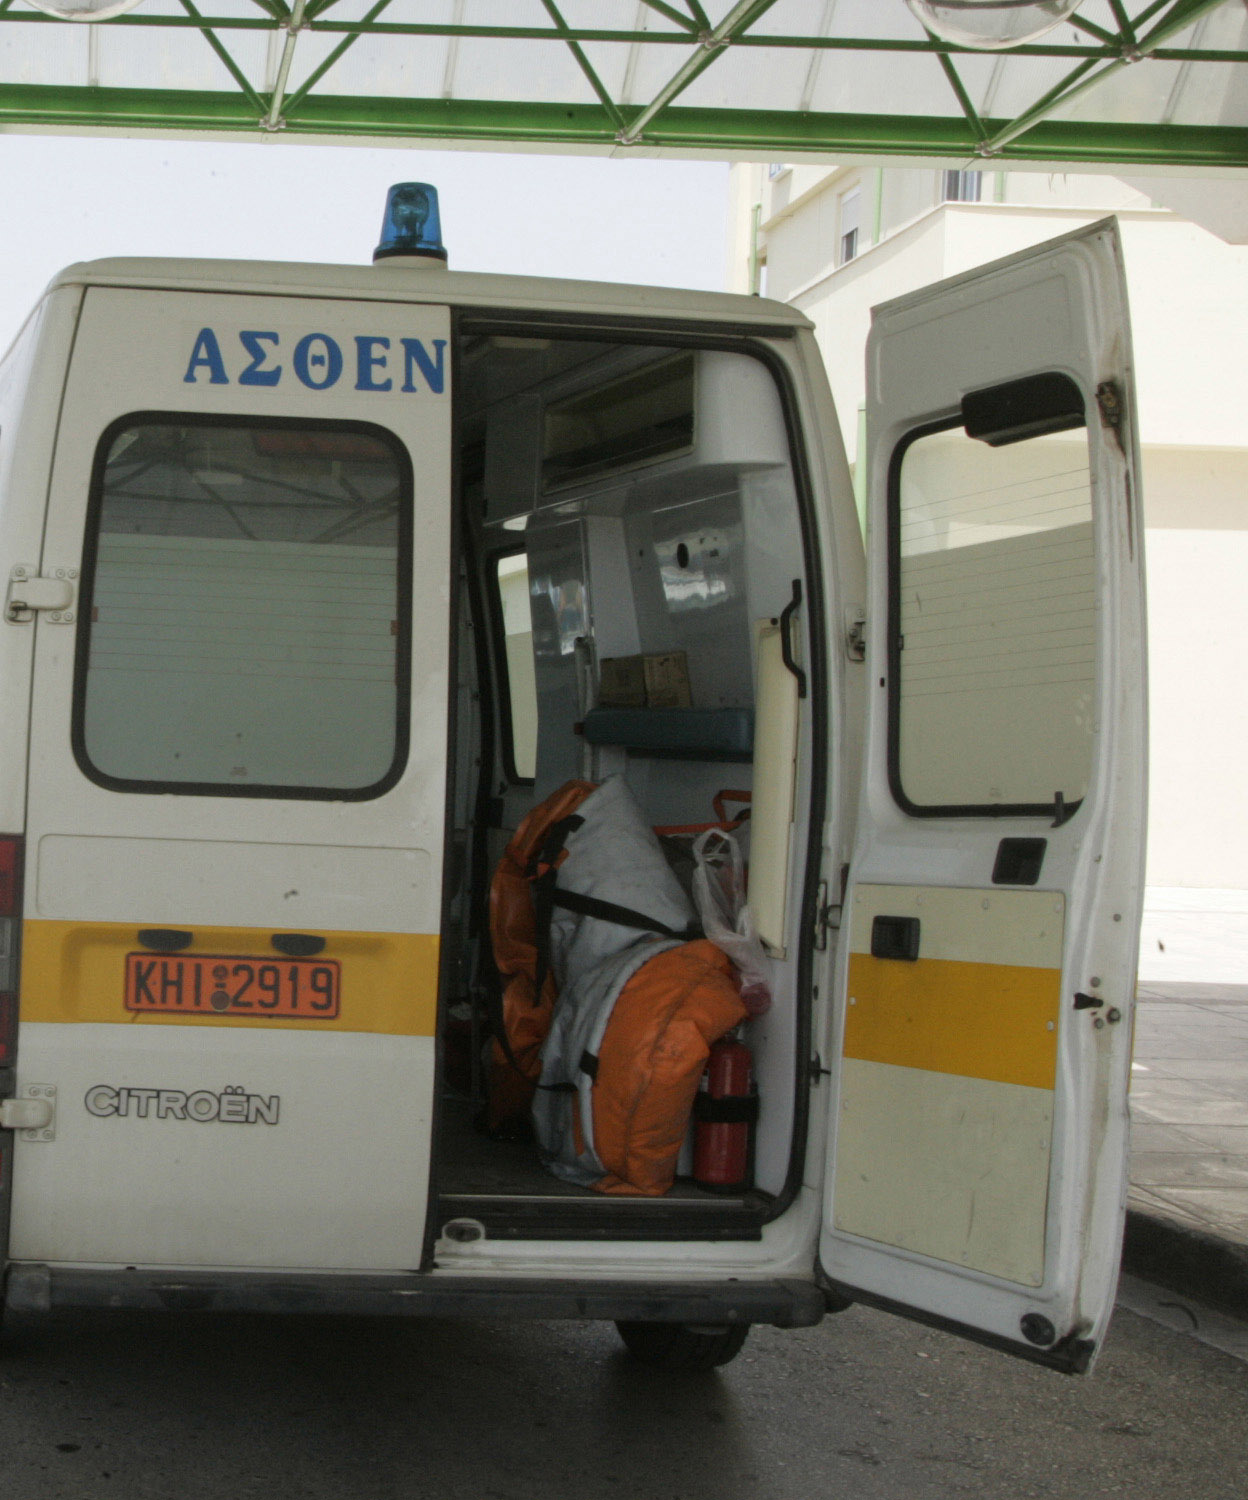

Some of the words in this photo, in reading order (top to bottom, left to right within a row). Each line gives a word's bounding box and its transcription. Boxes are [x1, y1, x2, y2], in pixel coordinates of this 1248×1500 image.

[183, 327, 448, 395] ΑΣΘΕΝ
[231, 963, 333, 1011] 2919
[84, 1084, 281, 1125] CITROËN
